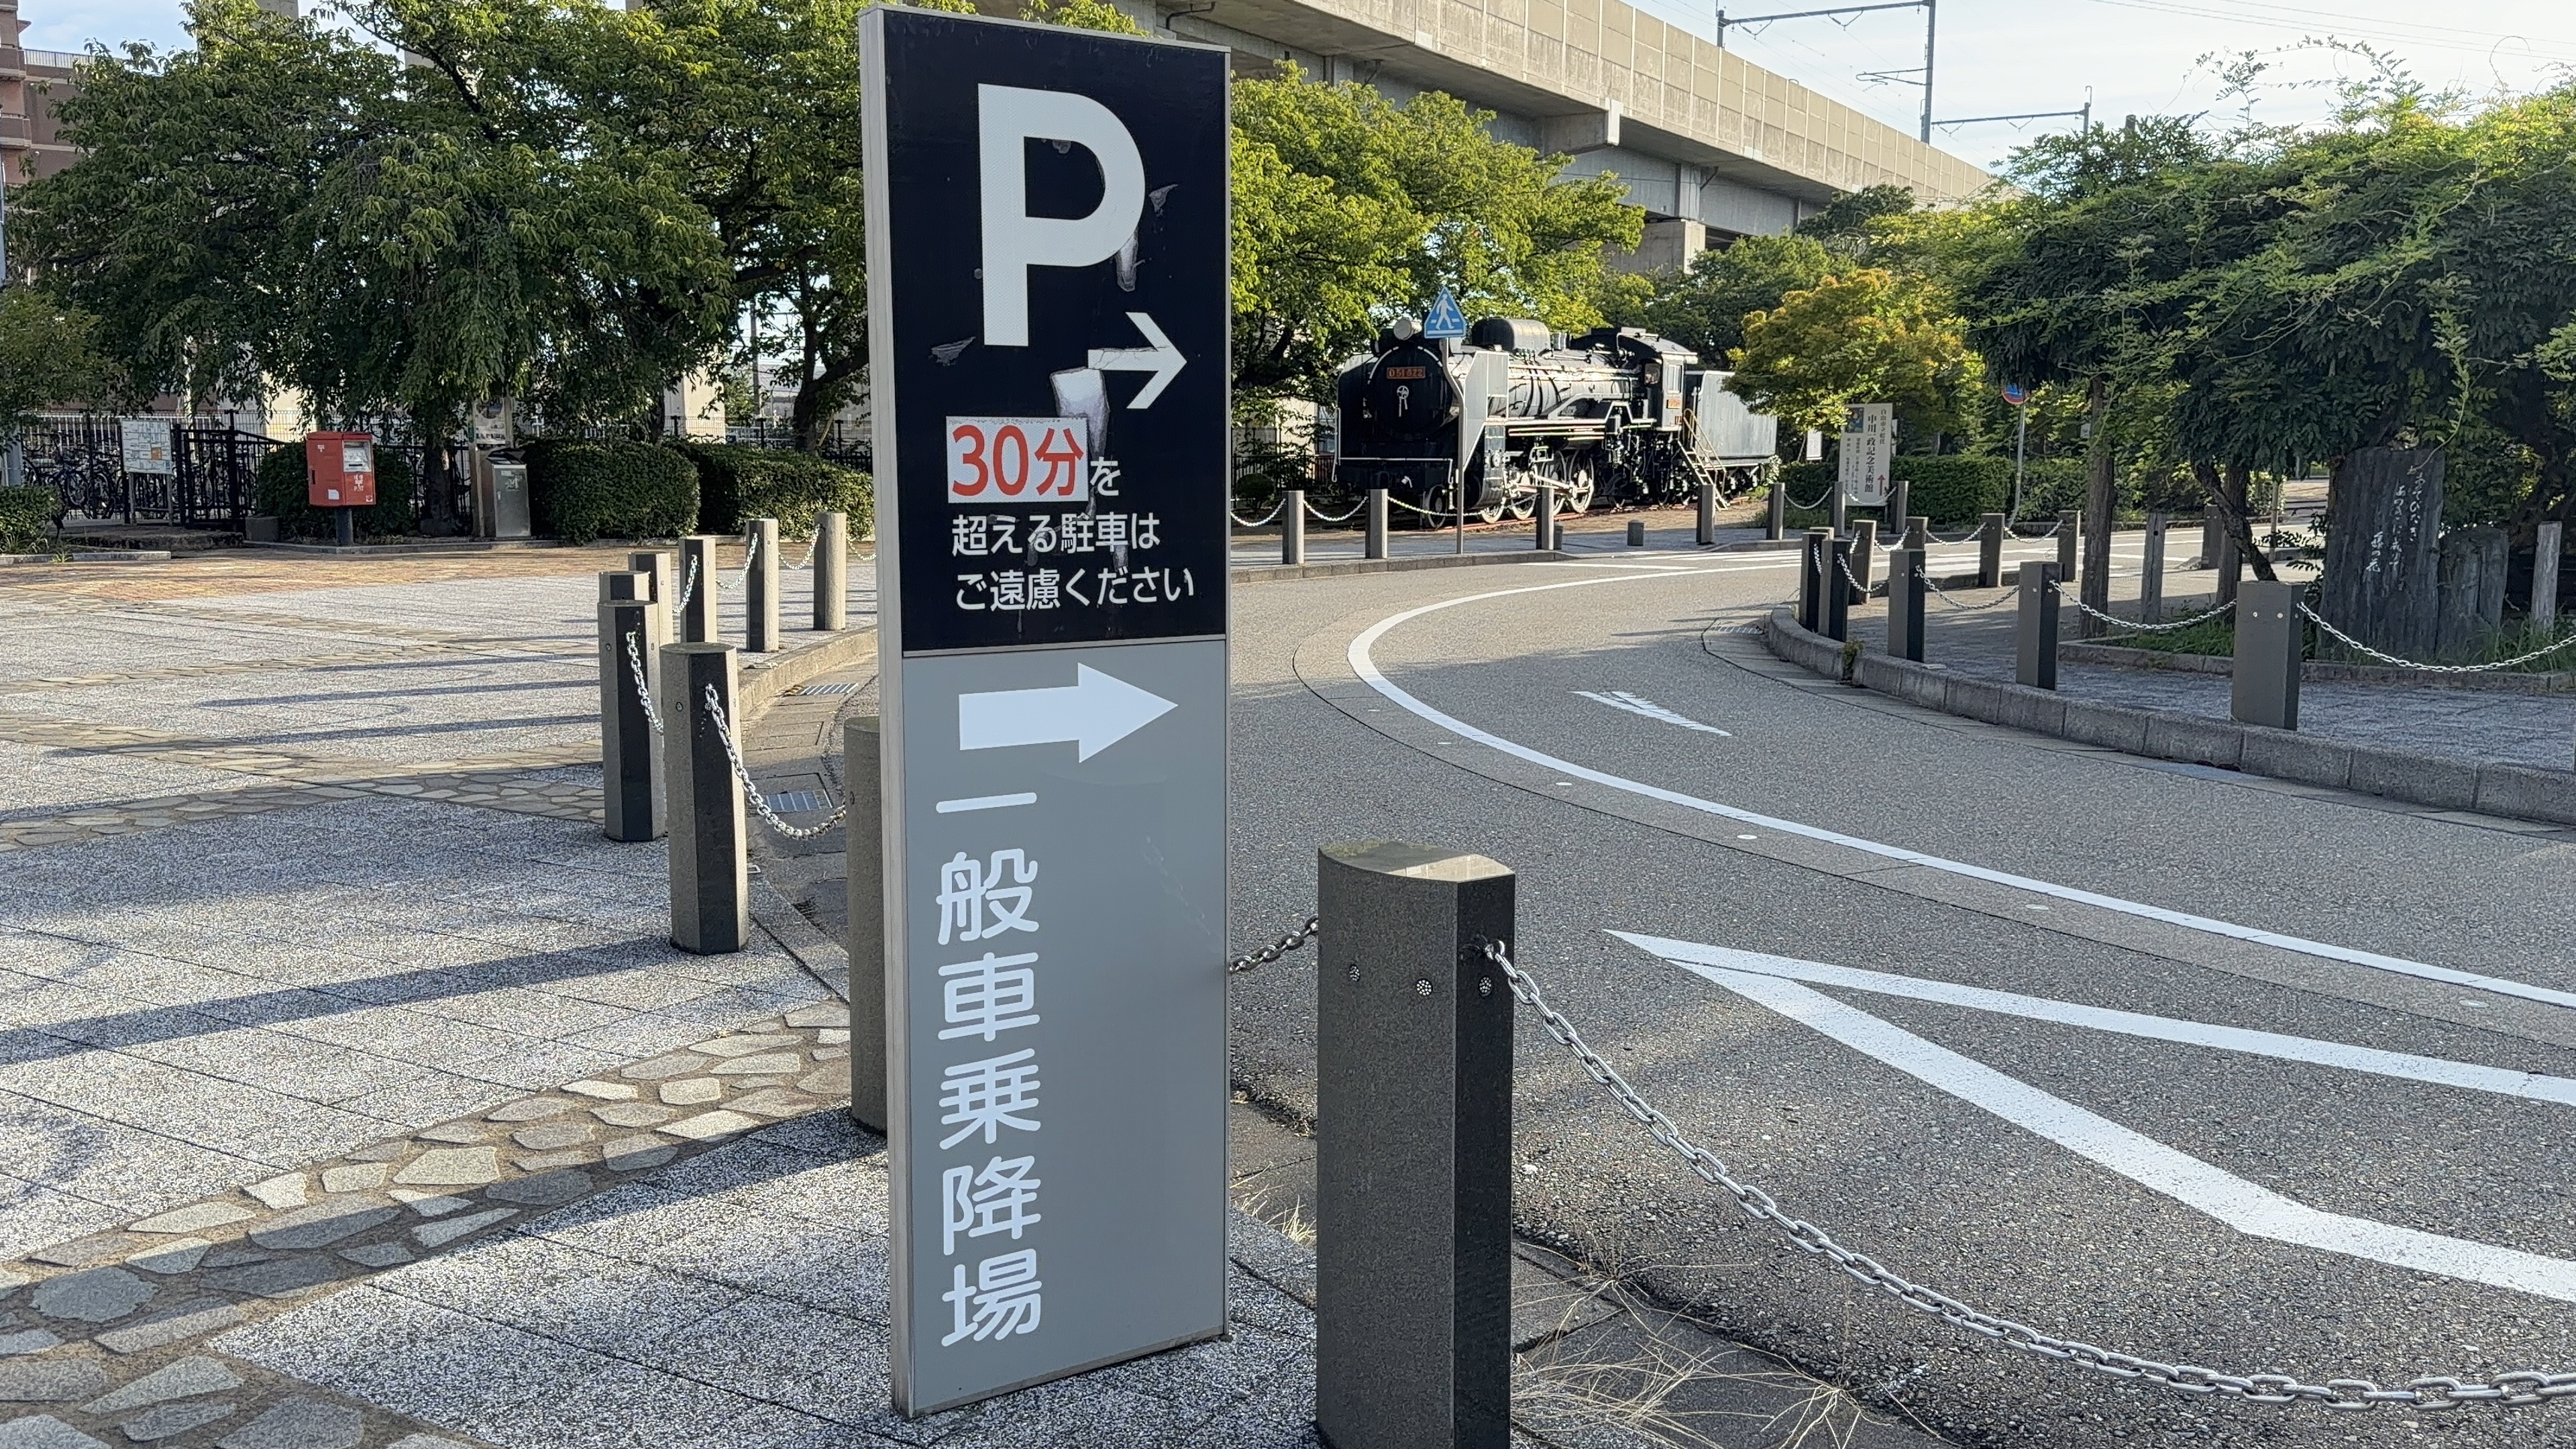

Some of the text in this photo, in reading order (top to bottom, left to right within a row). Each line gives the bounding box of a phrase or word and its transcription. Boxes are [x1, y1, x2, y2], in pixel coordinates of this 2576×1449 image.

[977, 83, 1146, 347] P
[1864, 414, 1877, 493] 中川一政記念美術館
[951, 511, 1161, 557] 超える駐車は
[956, 566, 1194, 612] ご遠慮ください
[935, 792, 1042, 1348] 一般車乗降場
